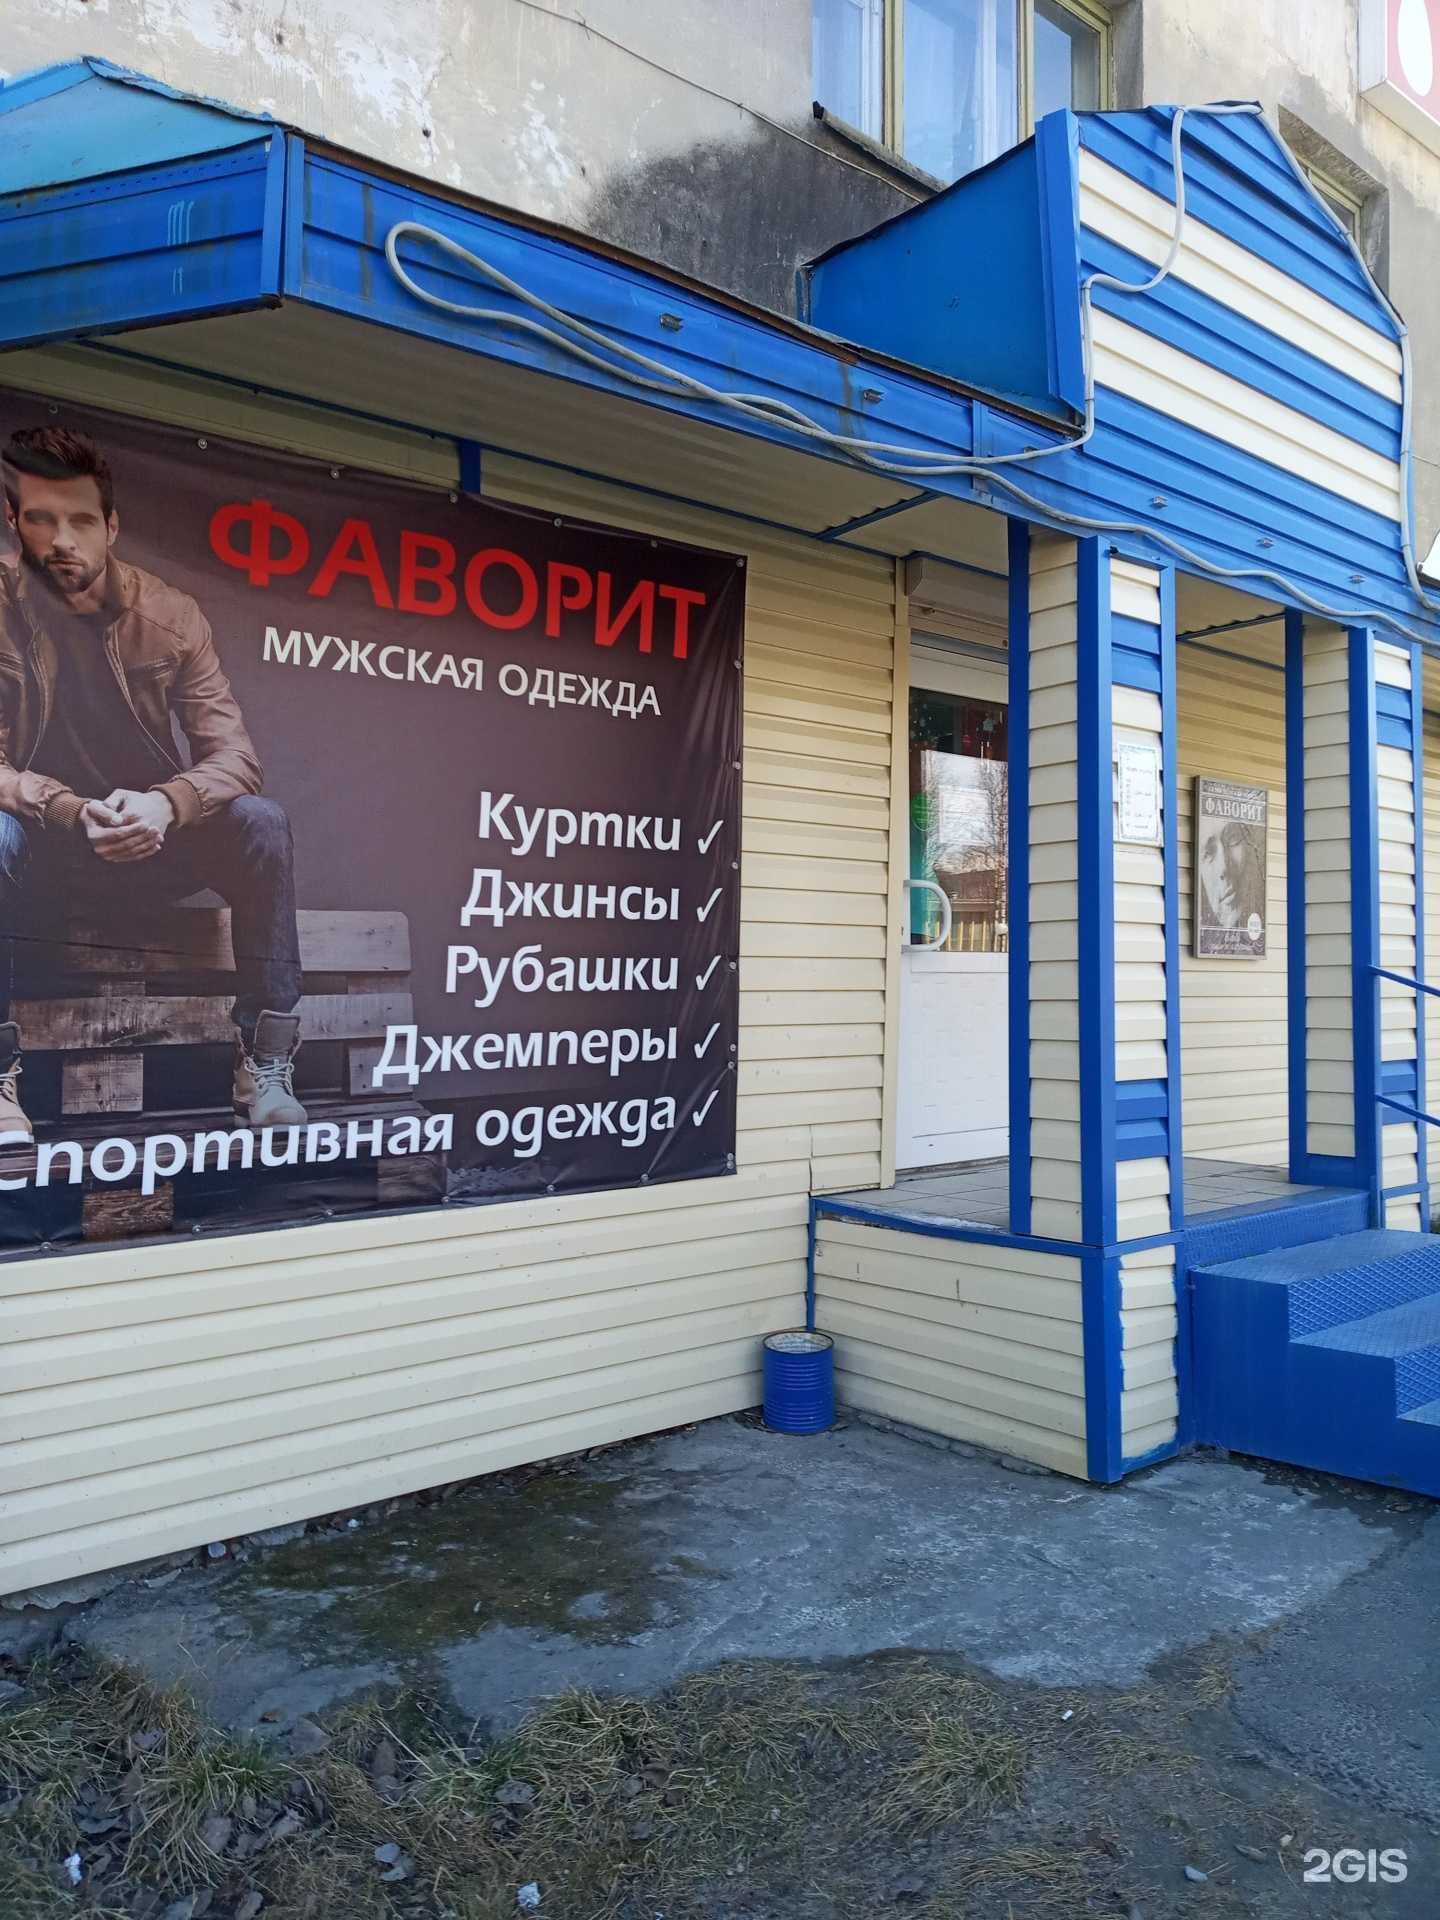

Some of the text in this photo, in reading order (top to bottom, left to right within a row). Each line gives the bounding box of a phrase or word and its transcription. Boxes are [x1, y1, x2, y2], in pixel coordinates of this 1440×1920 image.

[208, 498, 707, 660] ФАВОРИТ
[262, 625, 662, 720] МУЖСКАЯ ОДЕЖДА
[478, 790, 682, 858] Куртки
[1205, 797, 1264, 822] ФАВОРИТ
[460, 867, 681, 928] Джинсы
[445, 943, 679, 1009] Рубашки
[371, 1023, 678, 1088] Джемперы
[475, 1094, 676, 1158] одежда
